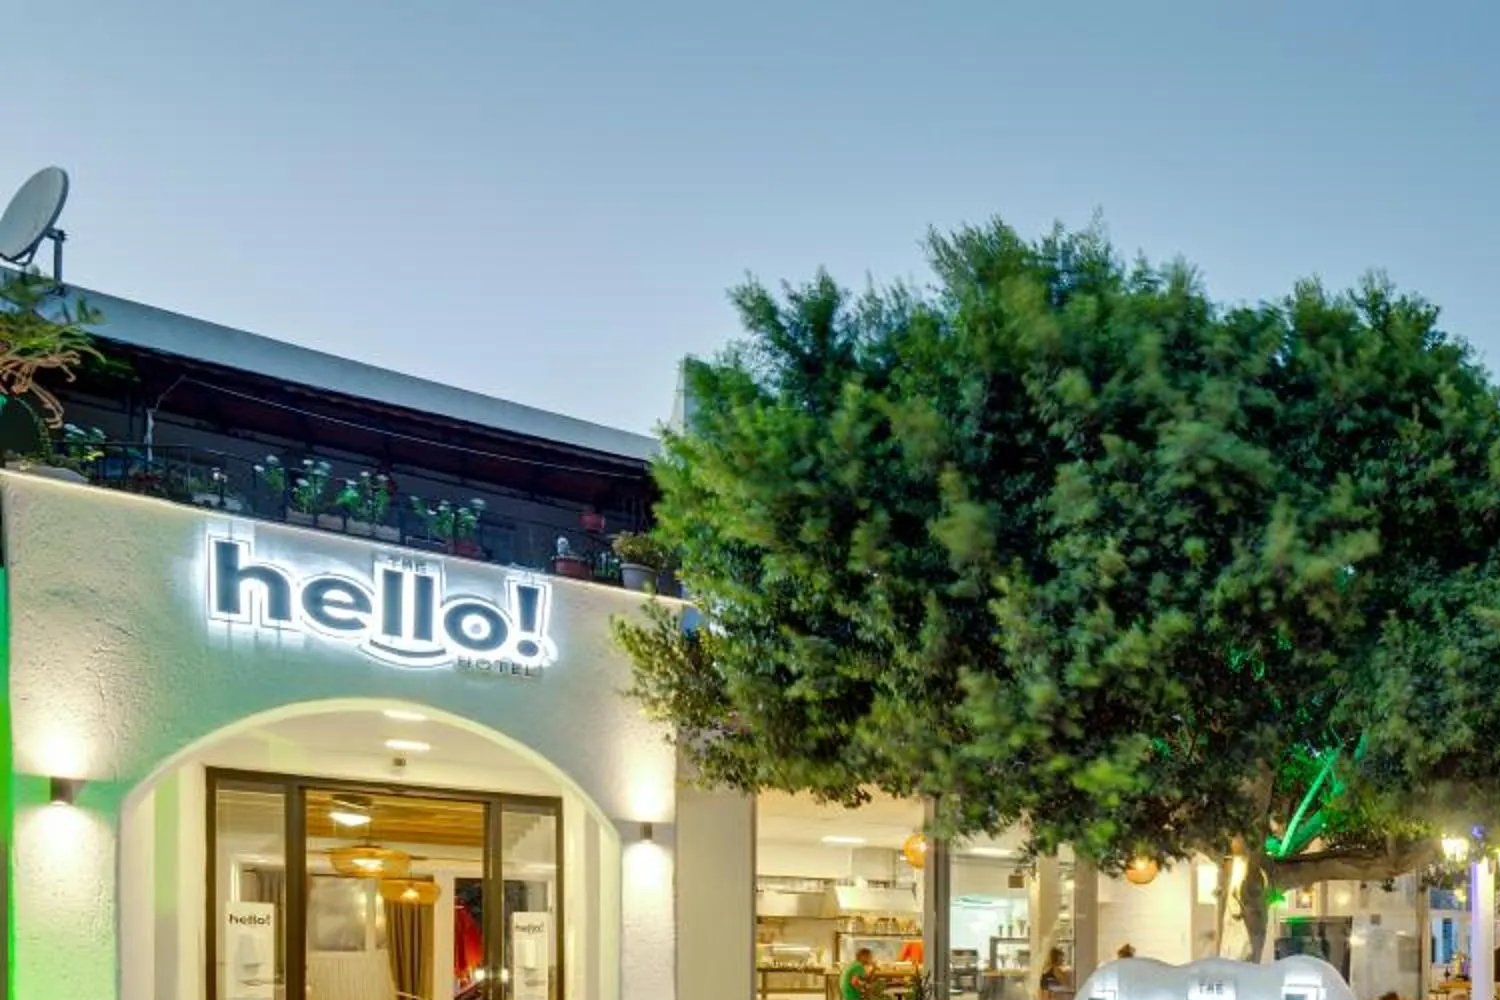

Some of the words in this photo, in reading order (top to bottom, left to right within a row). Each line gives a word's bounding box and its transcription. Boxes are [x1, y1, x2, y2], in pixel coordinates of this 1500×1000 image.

[214, 540, 541, 657] hello!
[457, 655, 534, 677] HOTEL
[229, 913, 271, 926] hello!
[1200, 983, 1223, 994] THE
